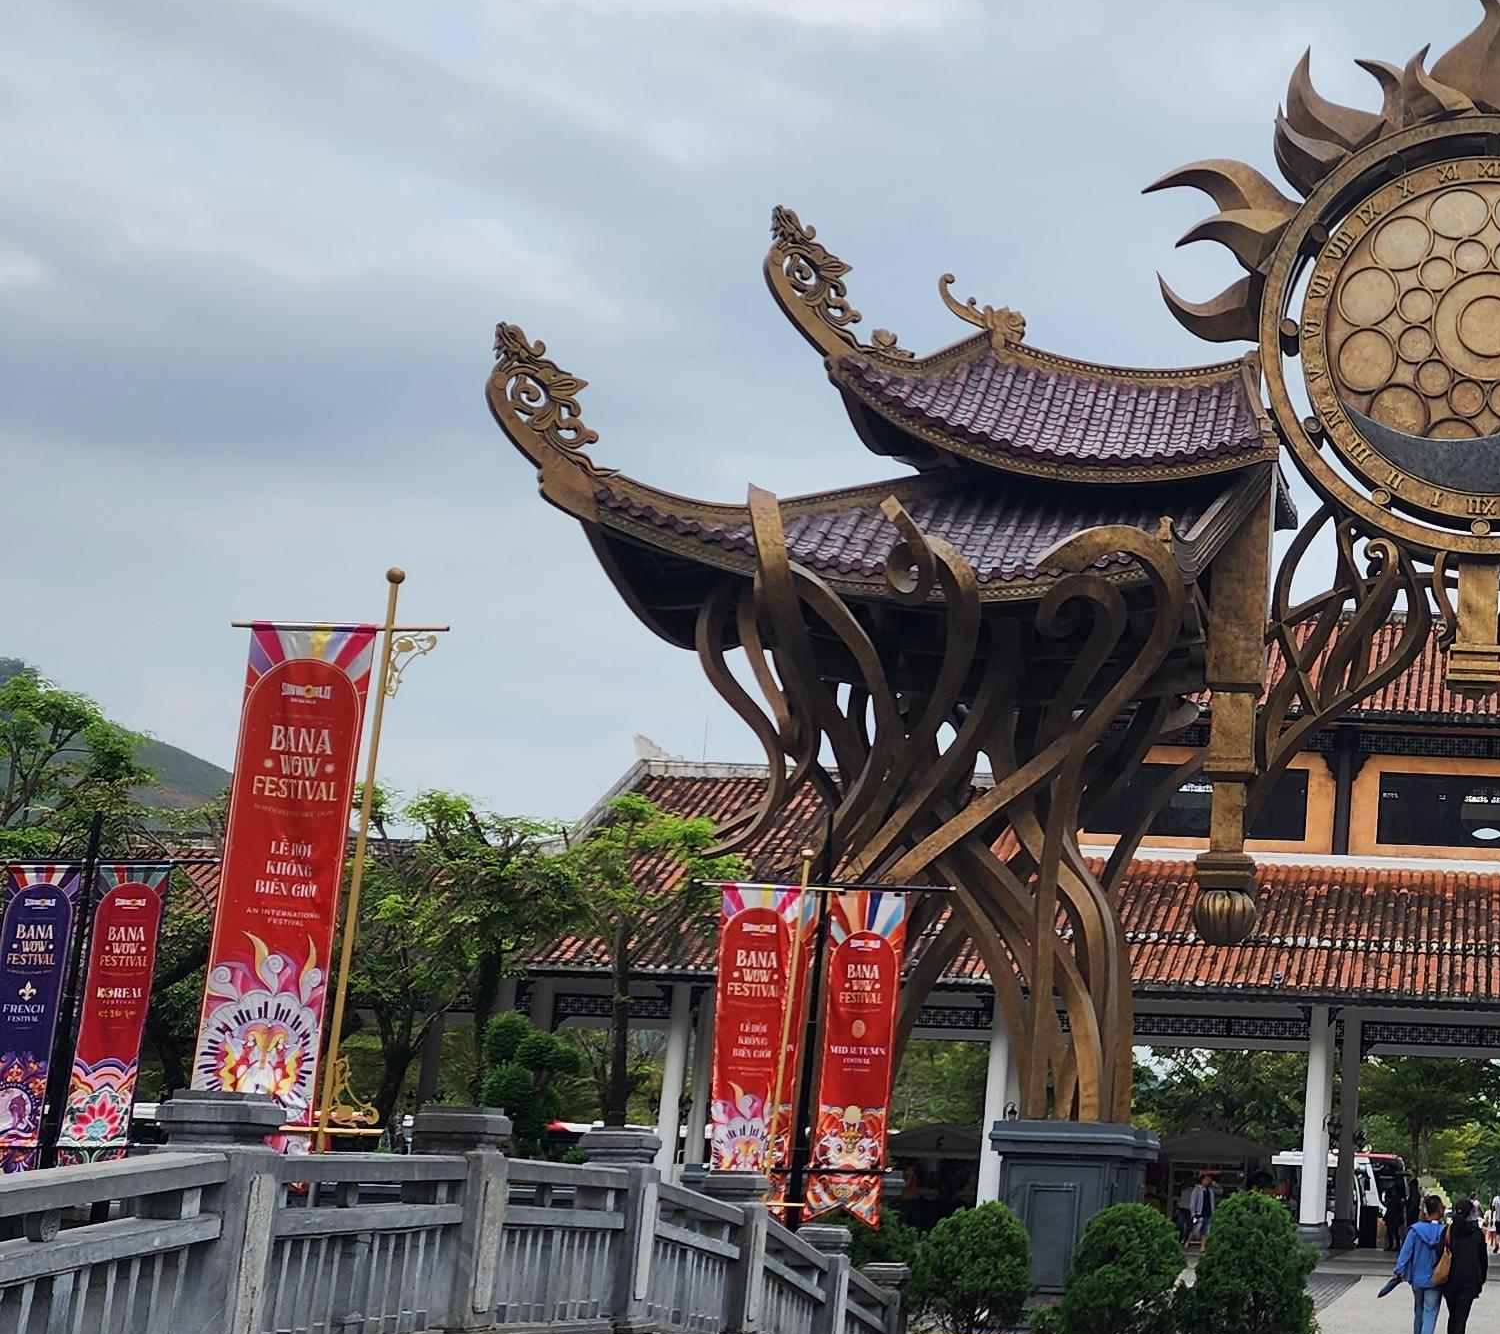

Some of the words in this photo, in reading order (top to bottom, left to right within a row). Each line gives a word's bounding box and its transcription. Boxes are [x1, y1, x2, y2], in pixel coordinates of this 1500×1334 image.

[1437, 164, 1460, 182] XI
[1396, 178, 1415, 198] X
[1355, 201, 1382, 227] IX
[1324, 229, 1357, 261] VIII
[1308, 274, 1332, 300] VII
[1303, 317, 1322, 340] VI
[1308, 370, 1326, 383] V
[1321, 405, 1346, 429] IV
[1346, 436, 1373, 465] III
[1384, 469, 1404, 491] II
[1431, 491, 1443, 507] I
[1466, 497, 1497, 515] XII
[270, 724, 333, 755] BANA
[280, 754, 322, 777] WOW
[252, 775, 338, 802] FESTIVAL
[16, 923, 53, 940] BANA
[108, 926, 145, 942] BANA
[22, 940, 48, 952] WOW
[112, 942, 139, 954] WOW
[6, 953, 55, 966] FESTIVAL
[100, 955, 148, 967] FESTIVAL
[736, 949, 778, 968] BANA
[742, 968, 771, 983] WOW
[847, 963, 880, 979] BANA
[727, 982, 779, 997] FESTIVAL
[851, 979, 874, 992] WOW
[839, 992, 882, 1004] FESTIVAL
[2, 1003, 45, 1014] FRENCH
[830, 1045, 848, 1055] MID
